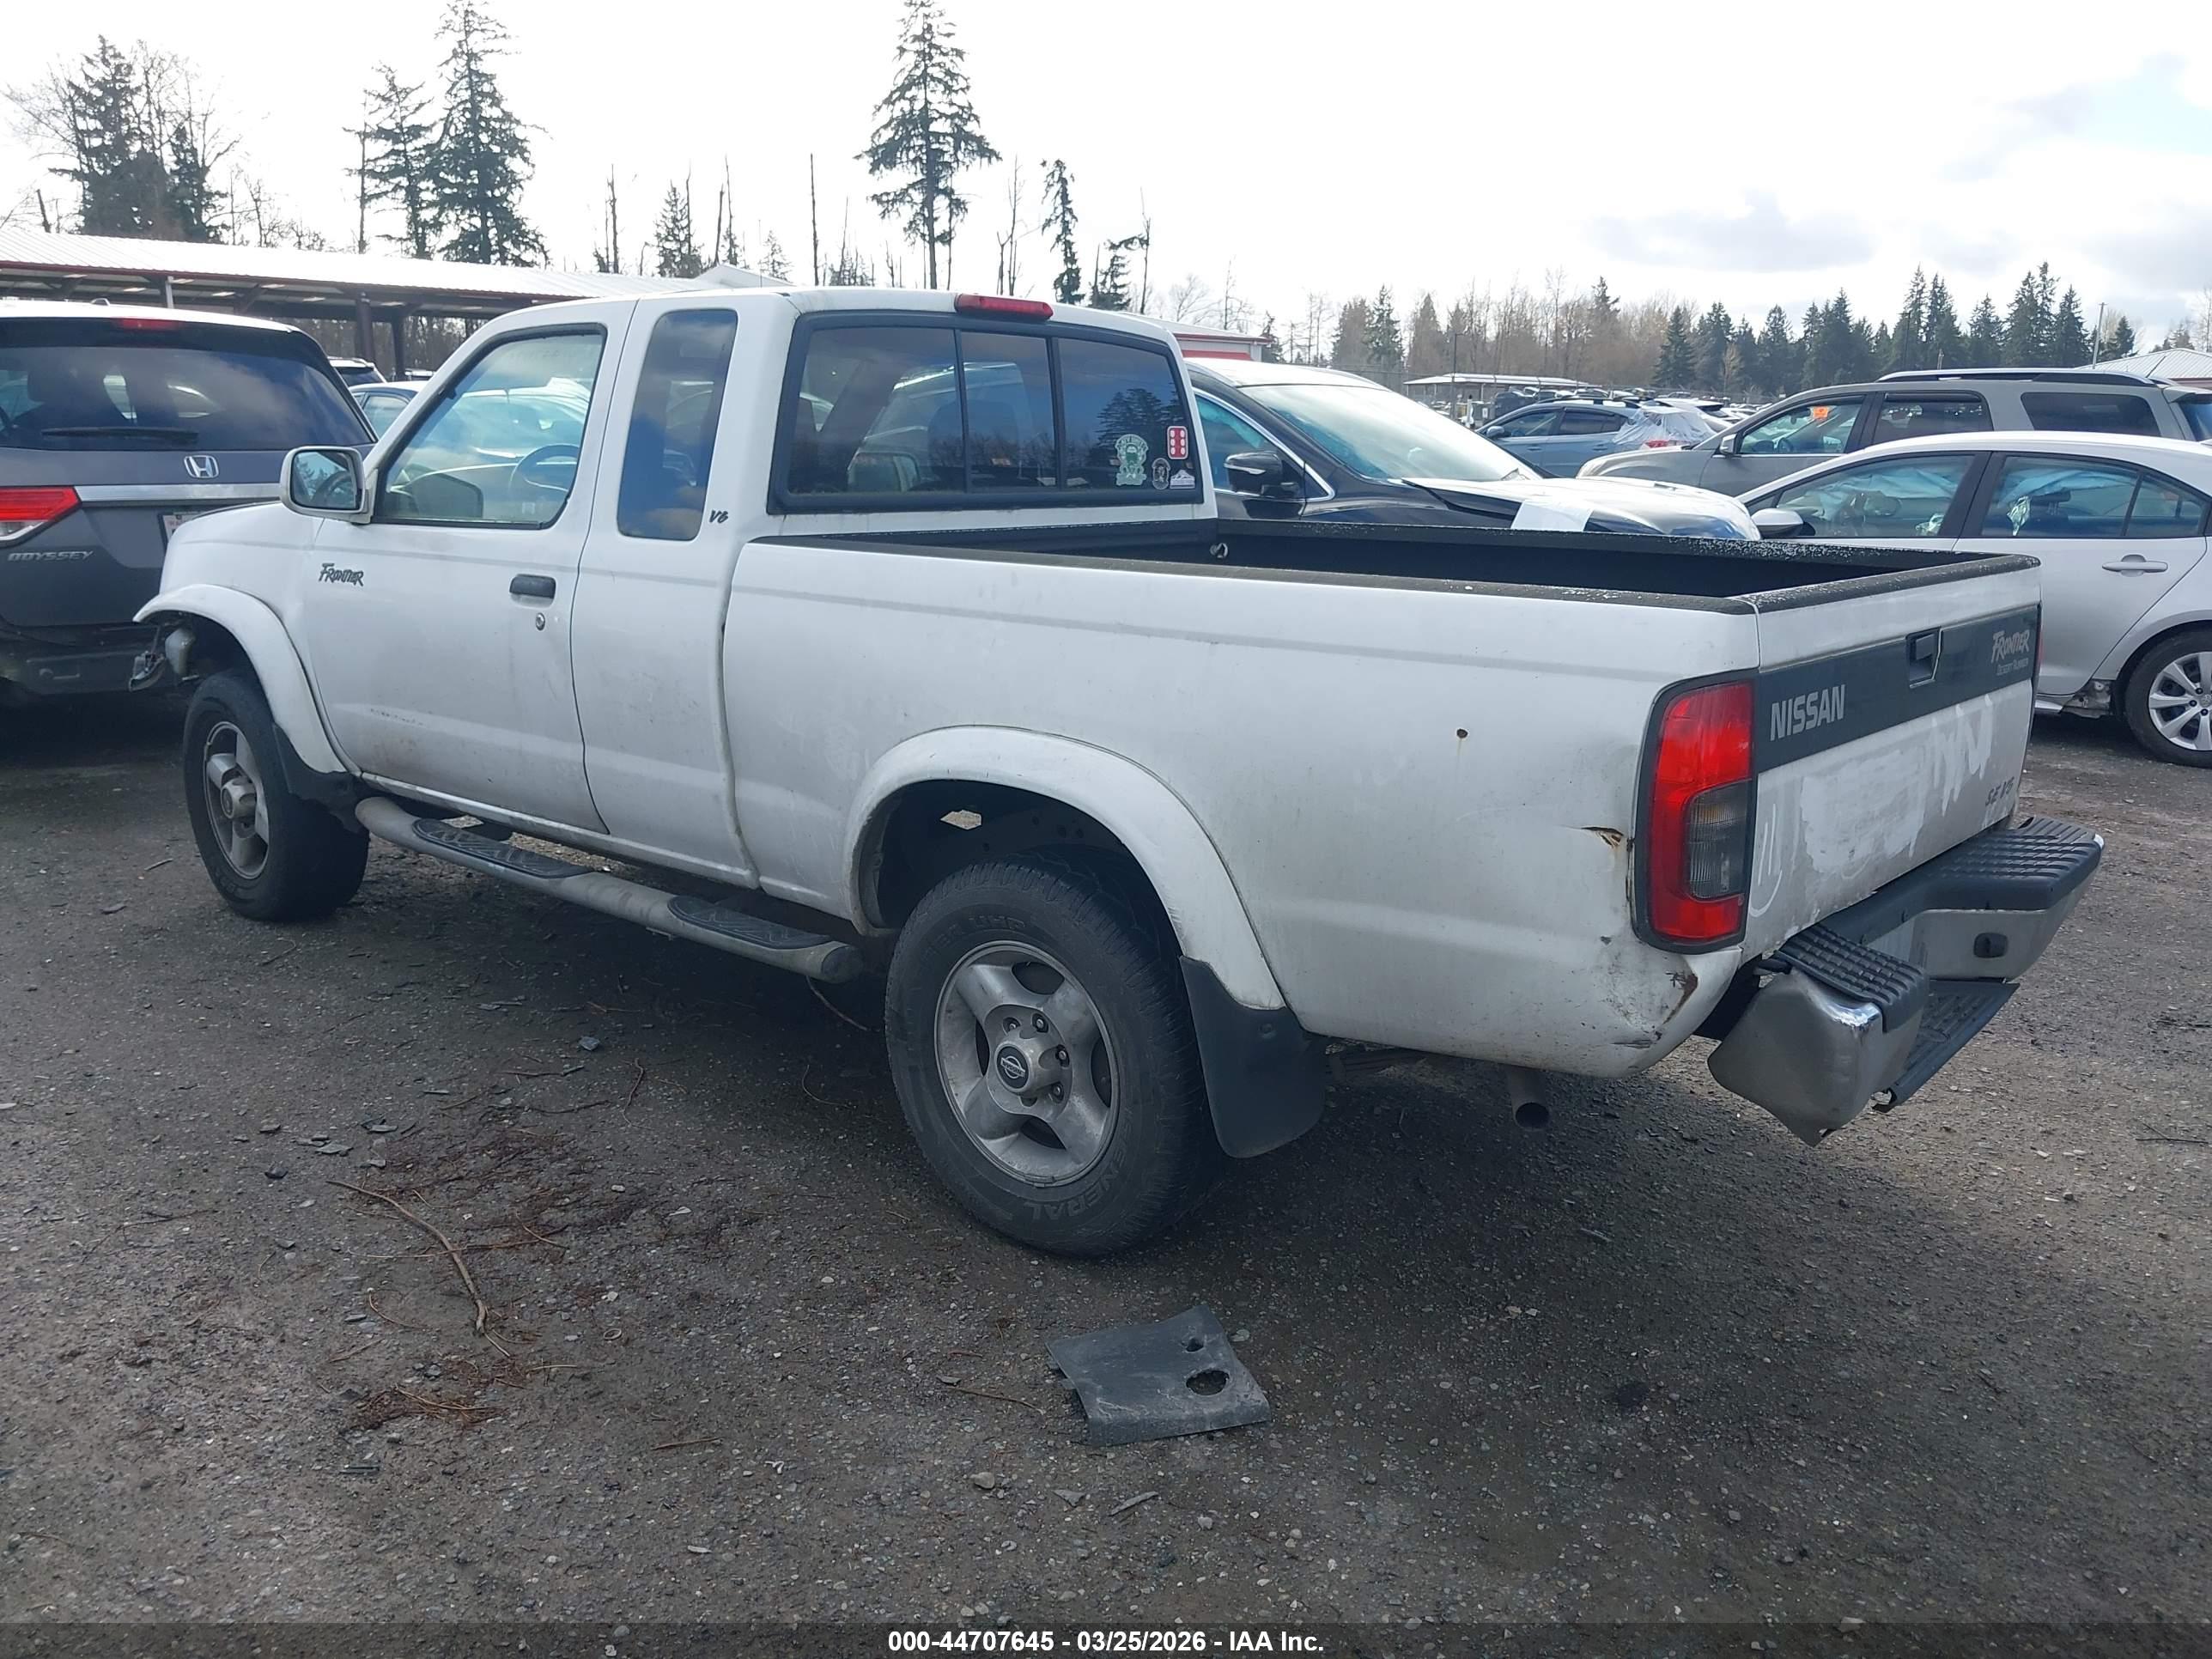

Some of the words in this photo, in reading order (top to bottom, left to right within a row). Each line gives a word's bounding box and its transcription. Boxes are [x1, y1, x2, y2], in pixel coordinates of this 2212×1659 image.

[708, 509, 729, 524] V6
[7, 550, 94, 562] ODYSSEY
[1770, 684, 1845, 742] NISSAN
[1985, 784, 2001, 807] SE
